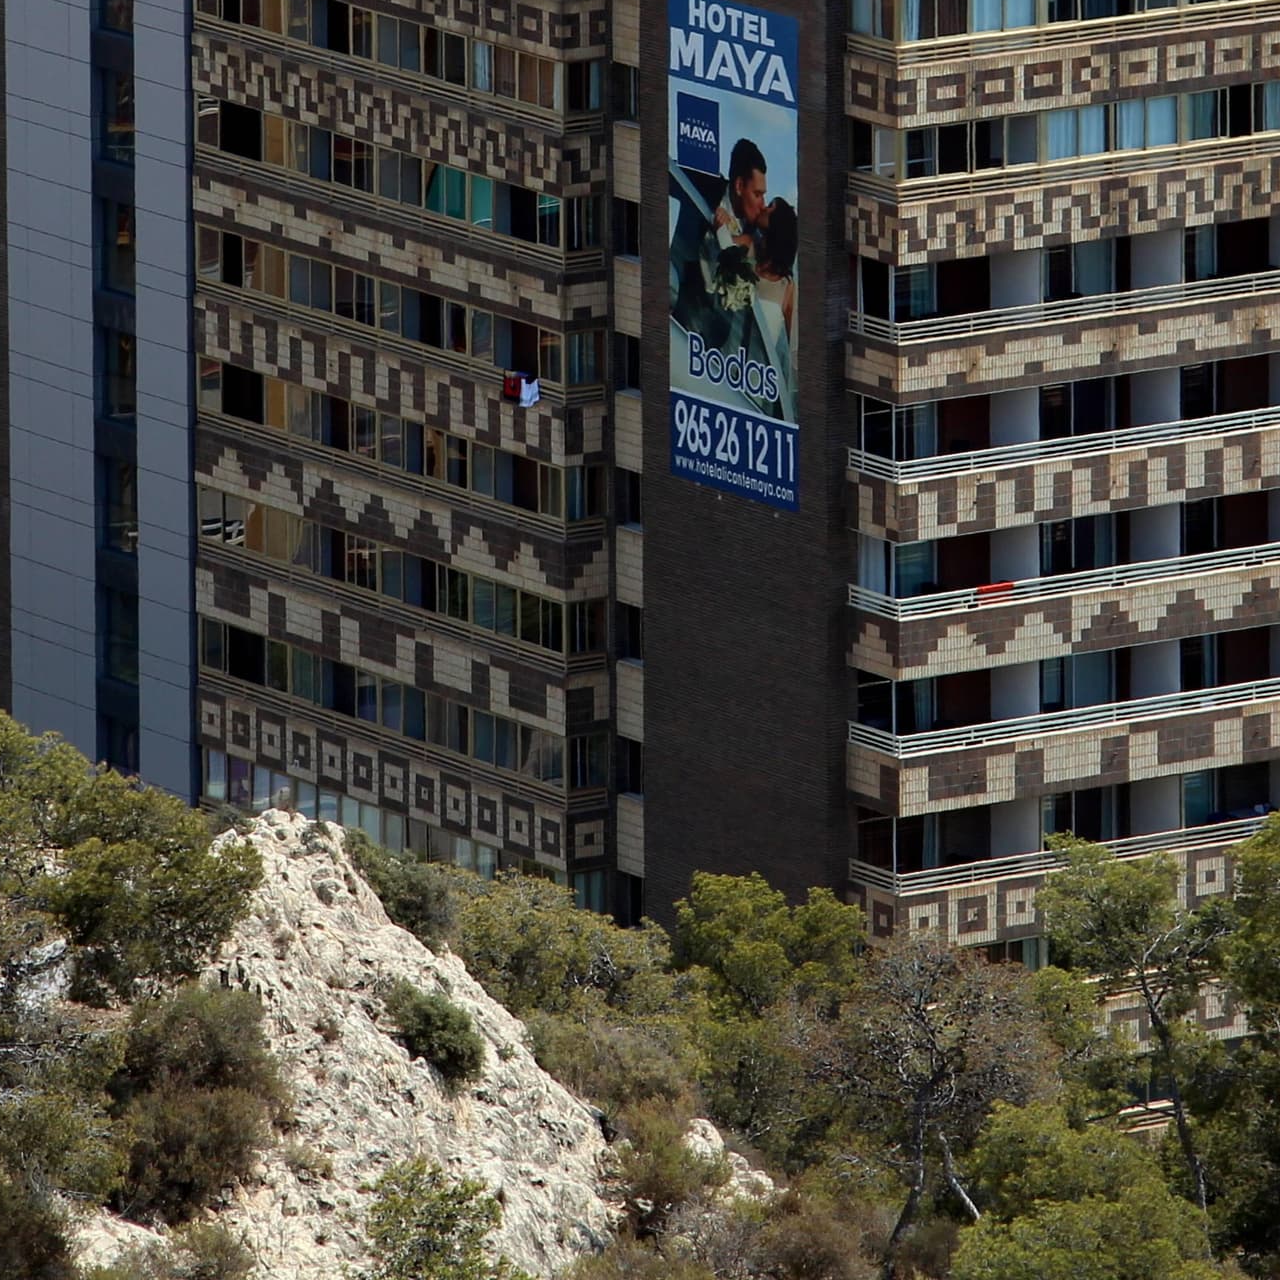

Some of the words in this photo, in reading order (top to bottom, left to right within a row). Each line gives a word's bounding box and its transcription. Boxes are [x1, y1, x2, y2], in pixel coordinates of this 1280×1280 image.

[670, 26, 795, 103] MAYA
[680, 121, 717, 145] MAYA
[688, 331, 779, 402] Bodas
[675, 399, 711, 457] 965
[715, 412, 740, 465] 26
[745, 421, 769, 475] 12
[775, 430, 794, 482] 11
